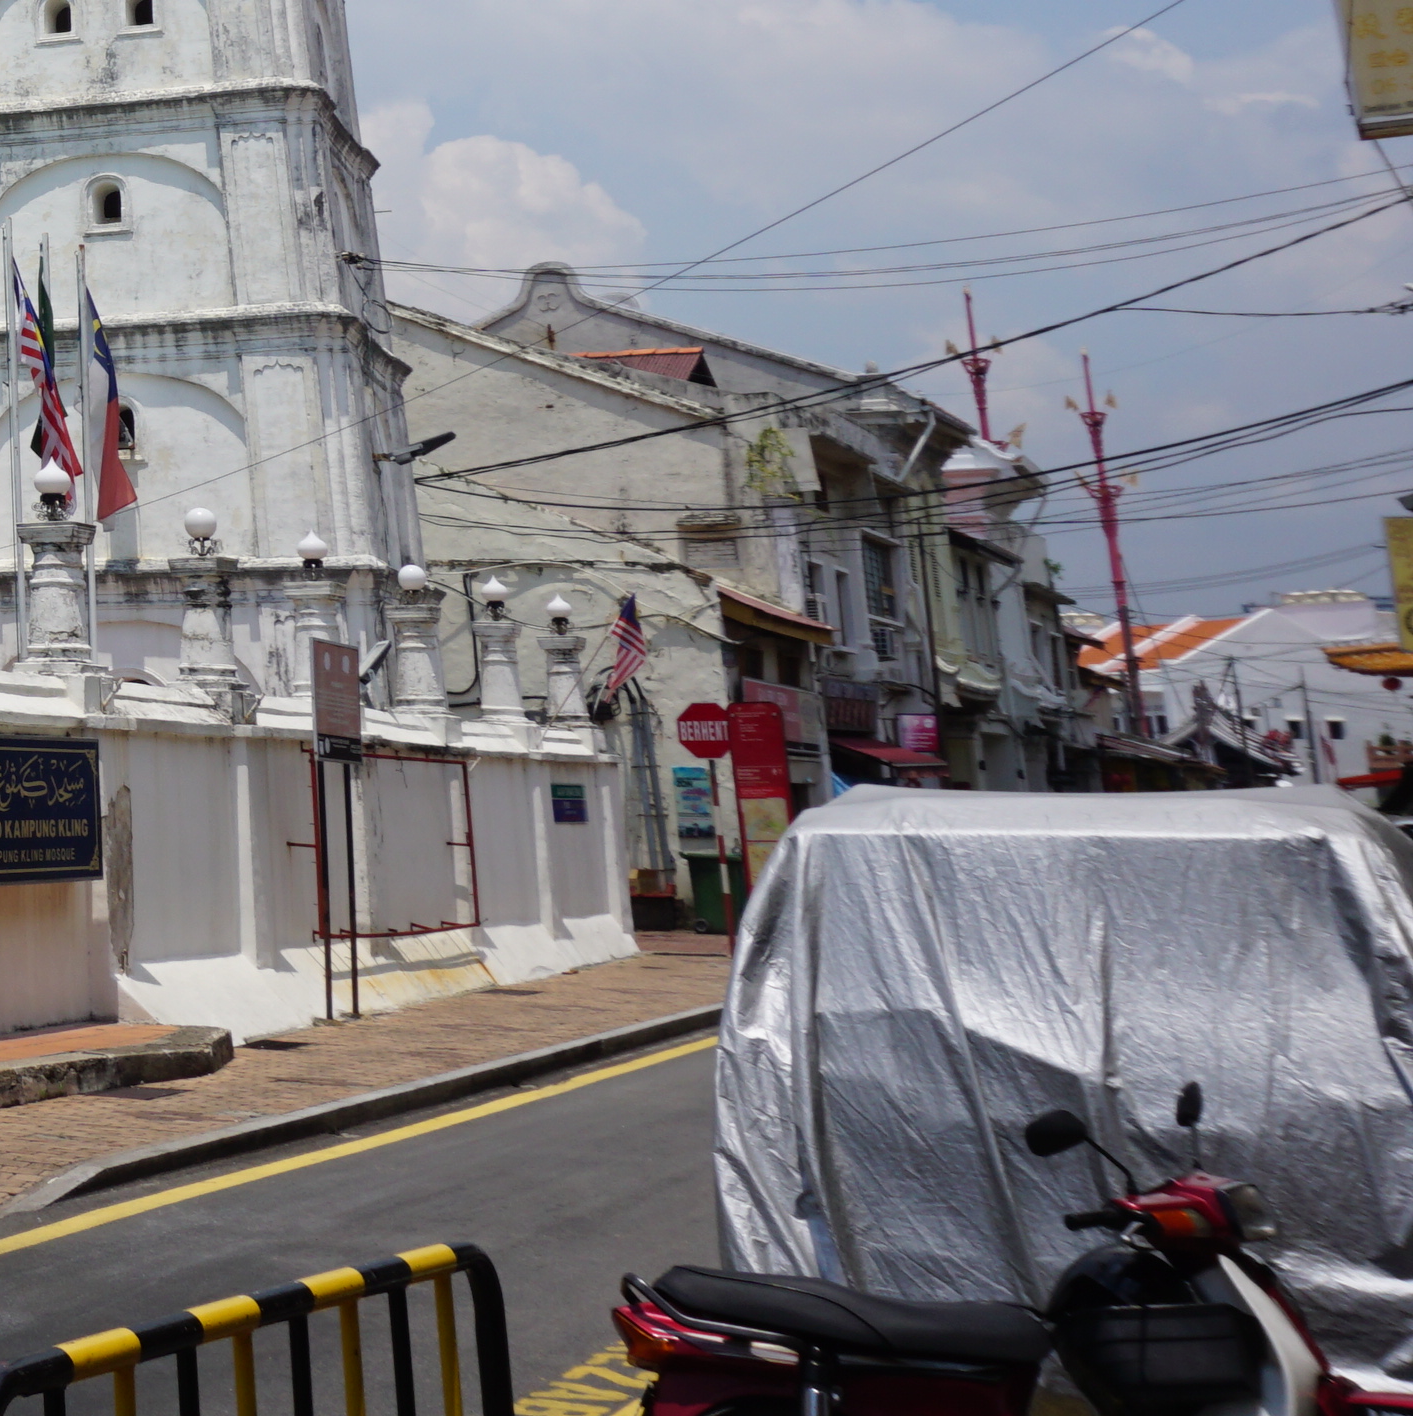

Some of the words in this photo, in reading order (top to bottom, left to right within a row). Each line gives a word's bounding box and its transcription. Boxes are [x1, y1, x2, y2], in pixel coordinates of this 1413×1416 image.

[679, 720, 729, 742] BERHENT
[4, 819, 56, 839] KAMPUNG
[58, 818, 89, 837] KLING
[20, 848, 44, 863] KLING
[45, 847, 76, 862] MOSQUE
